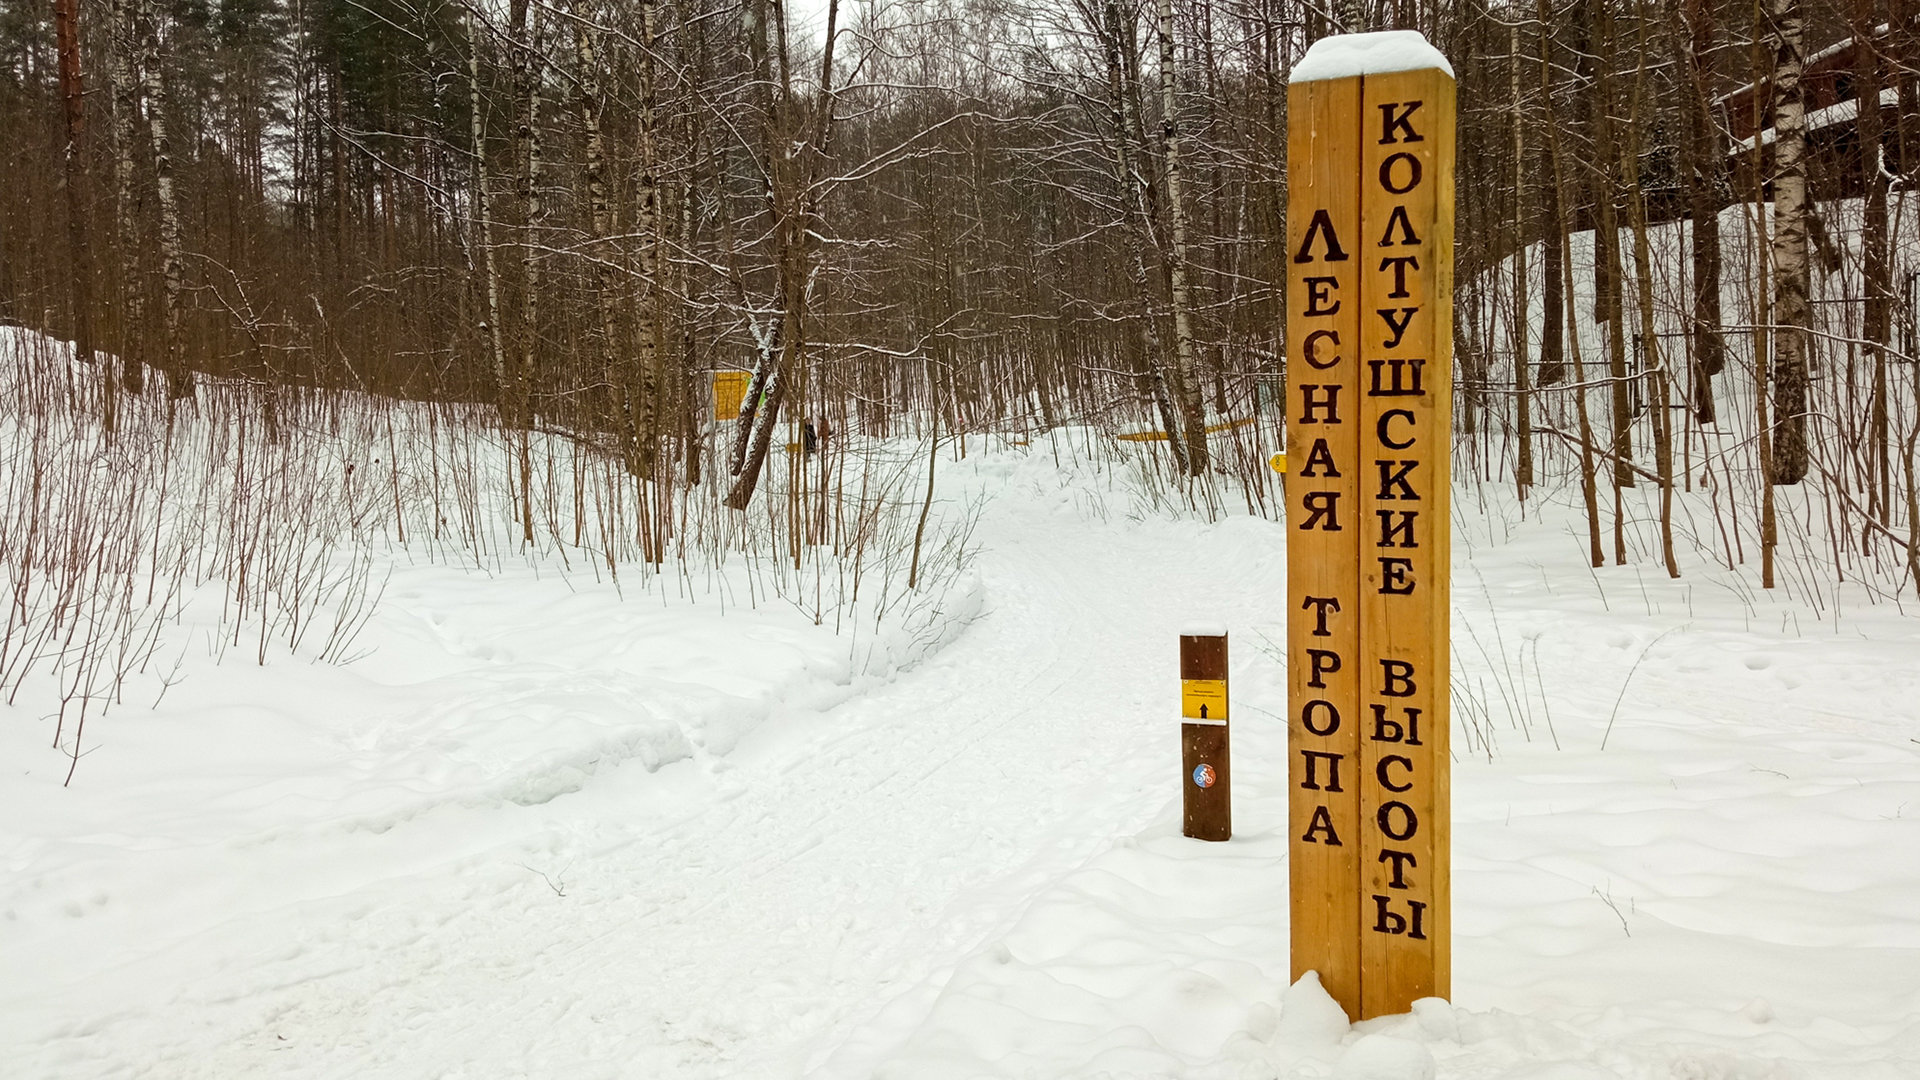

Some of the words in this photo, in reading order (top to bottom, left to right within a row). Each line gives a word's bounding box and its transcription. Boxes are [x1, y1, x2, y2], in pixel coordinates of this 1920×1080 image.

[1294, 209, 1349, 531] ЛЕСНАЯ
[1367, 100, 1426, 595] КОЛТУШСКИЕ
[1301, 596, 1344, 847] ТРОПА
[1370, 658, 1428, 940] ВЫСОТЫ
